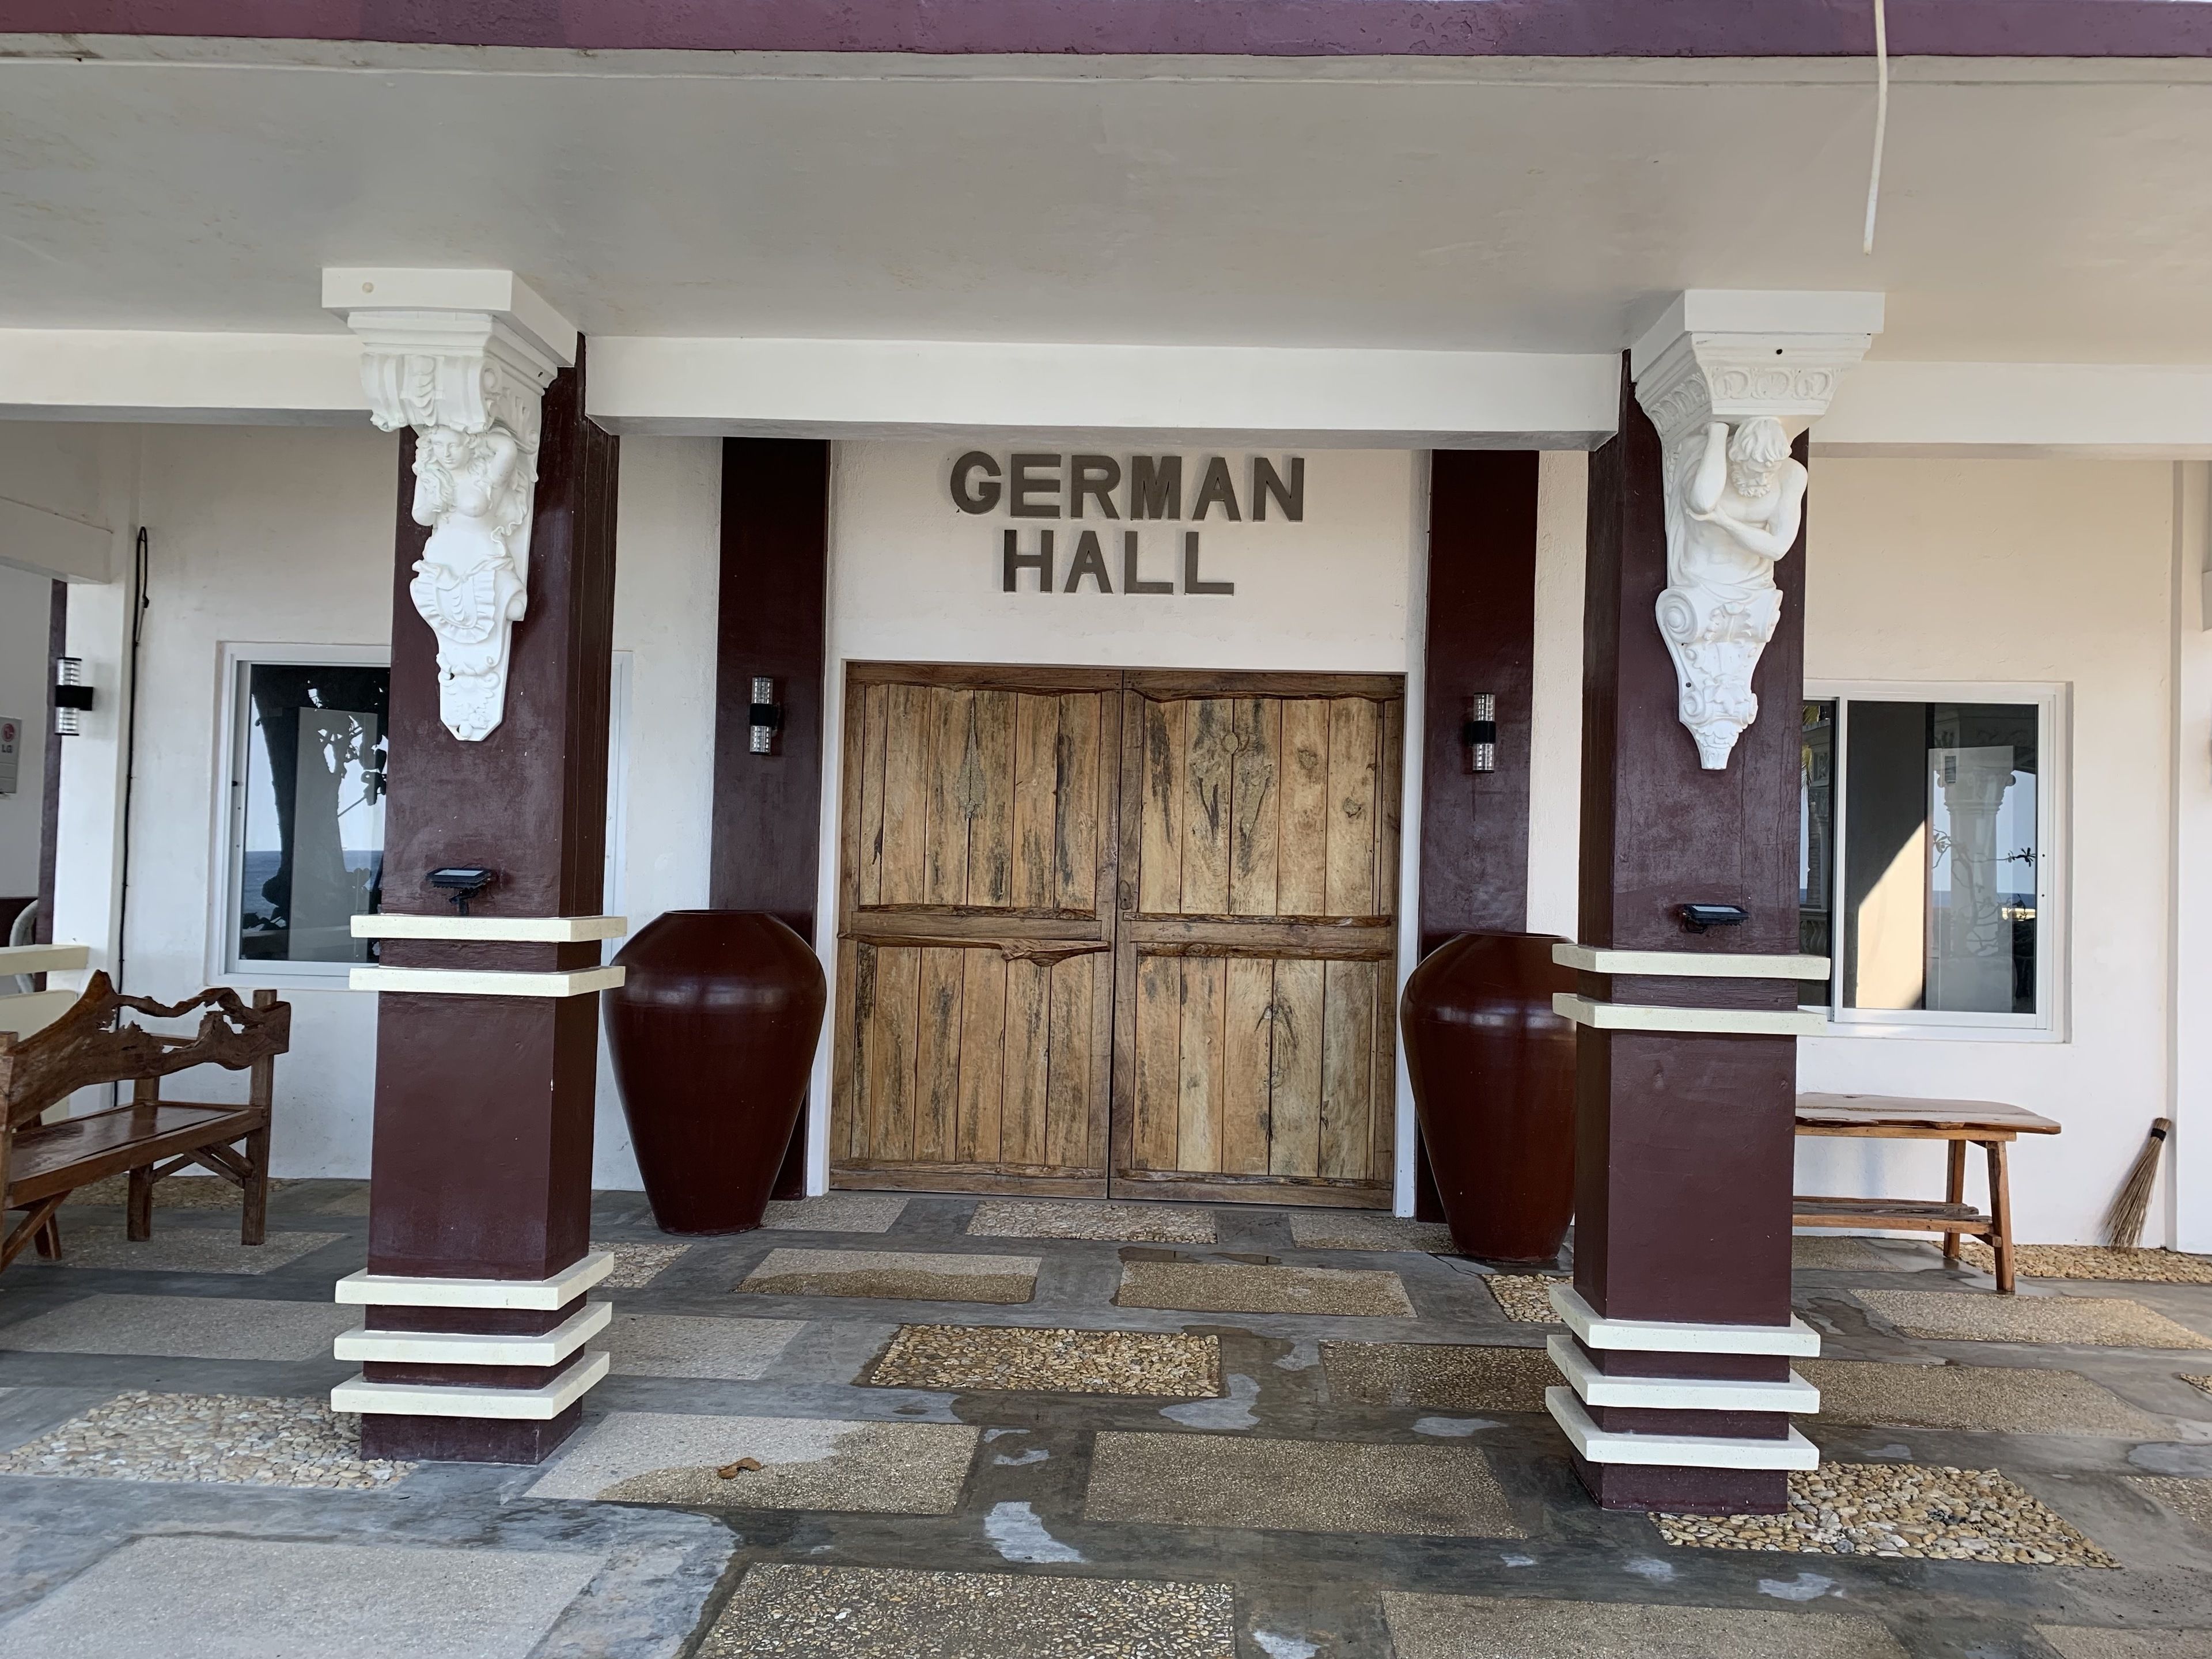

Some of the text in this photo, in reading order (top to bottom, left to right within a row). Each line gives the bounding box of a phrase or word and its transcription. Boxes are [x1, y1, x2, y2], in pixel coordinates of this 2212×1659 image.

[950, 450, 1305, 522] GERMAN
[1003, 529, 1234, 596] HALL
[1, 744, 13, 753] LG
